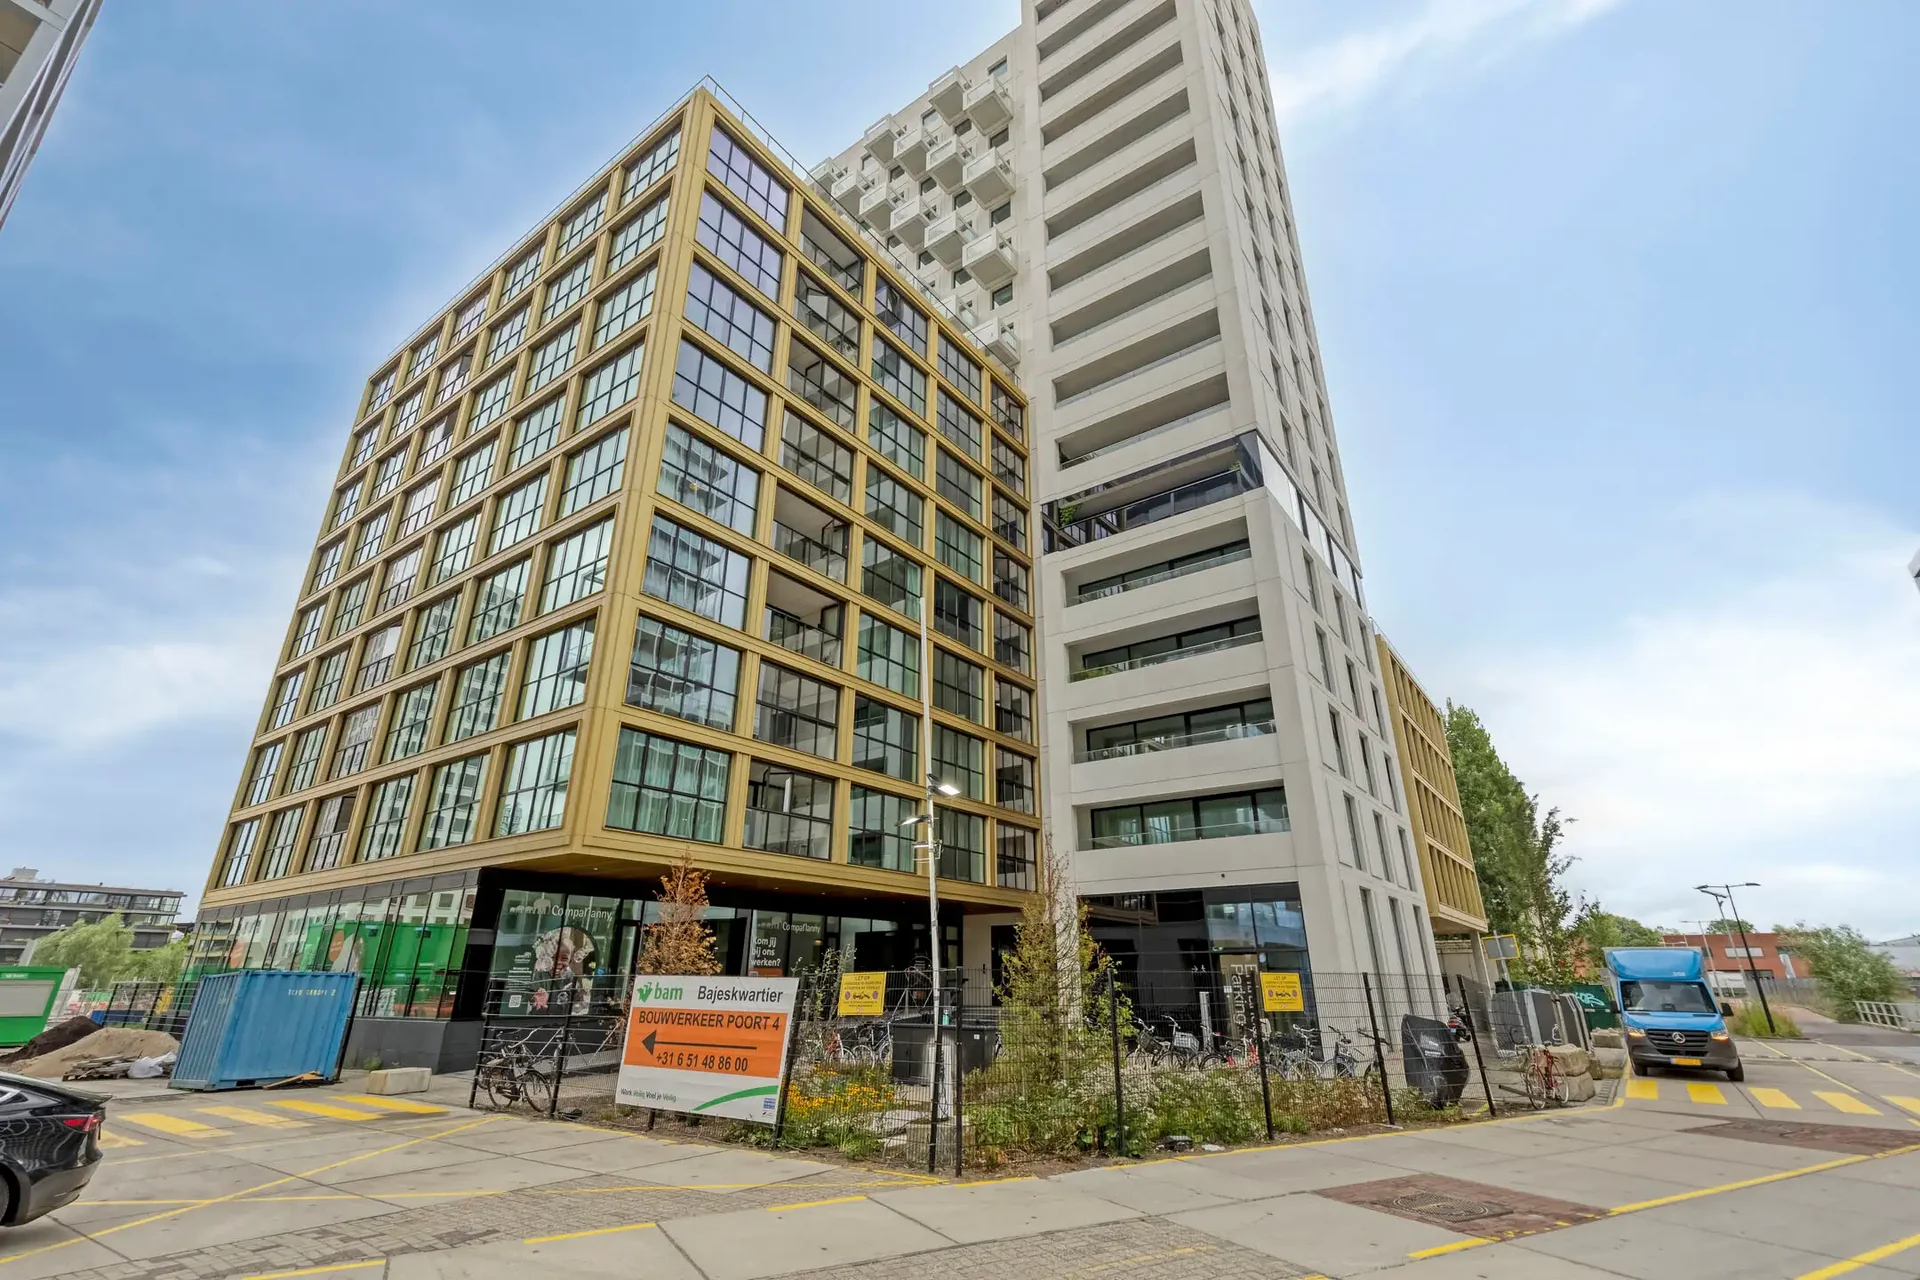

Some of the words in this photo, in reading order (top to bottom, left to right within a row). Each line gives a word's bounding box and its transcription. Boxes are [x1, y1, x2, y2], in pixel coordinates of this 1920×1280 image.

[753, 937, 768, 945] Kom
[769, 937, 777, 947] jij
[752, 947, 761, 957] bij
[750, 958, 781, 966] werken?
[654, 982, 683, 1001] bam
[698, 986, 784, 1004] Bajeskwartier
[1230, 964, 1247, 1024] Parking
[638, 1010, 724, 1028] BOUWVERKEER
[726, 1015, 769, 1030] POORT
[772, 1018, 780, 1030] 4
[656, 1052, 673, 1065] +31
[677, 1053, 684, 1066] 6
[687, 1054, 698, 1068] 51
[702, 1055, 714, 1069] 48
[718, 1056, 731, 1070] 86
[735, 1058, 748, 1072] 00
[663, 1093, 676, 1103] Veilig
